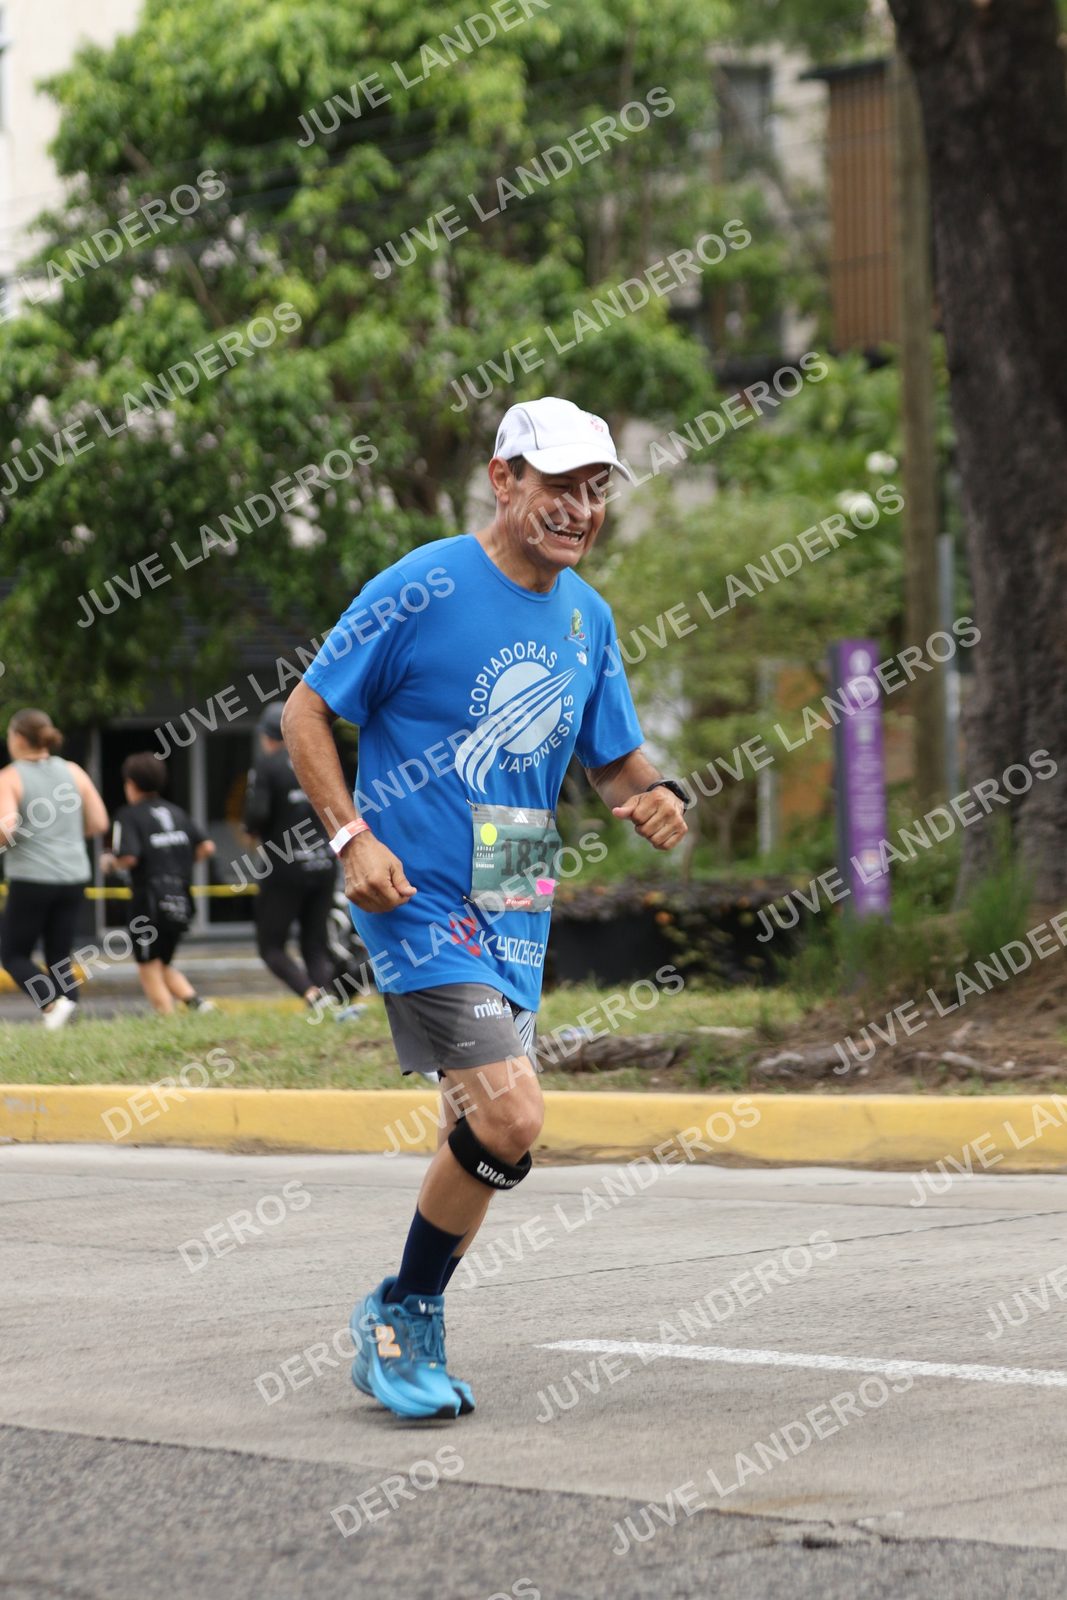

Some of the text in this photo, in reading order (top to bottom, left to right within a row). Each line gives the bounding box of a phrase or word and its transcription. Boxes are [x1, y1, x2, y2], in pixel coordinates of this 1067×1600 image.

[469, 641, 557, 716] COPIADORAS
[499, 694, 573, 773] JAPONESAS
[479, 930, 544, 967] KYOCERA
